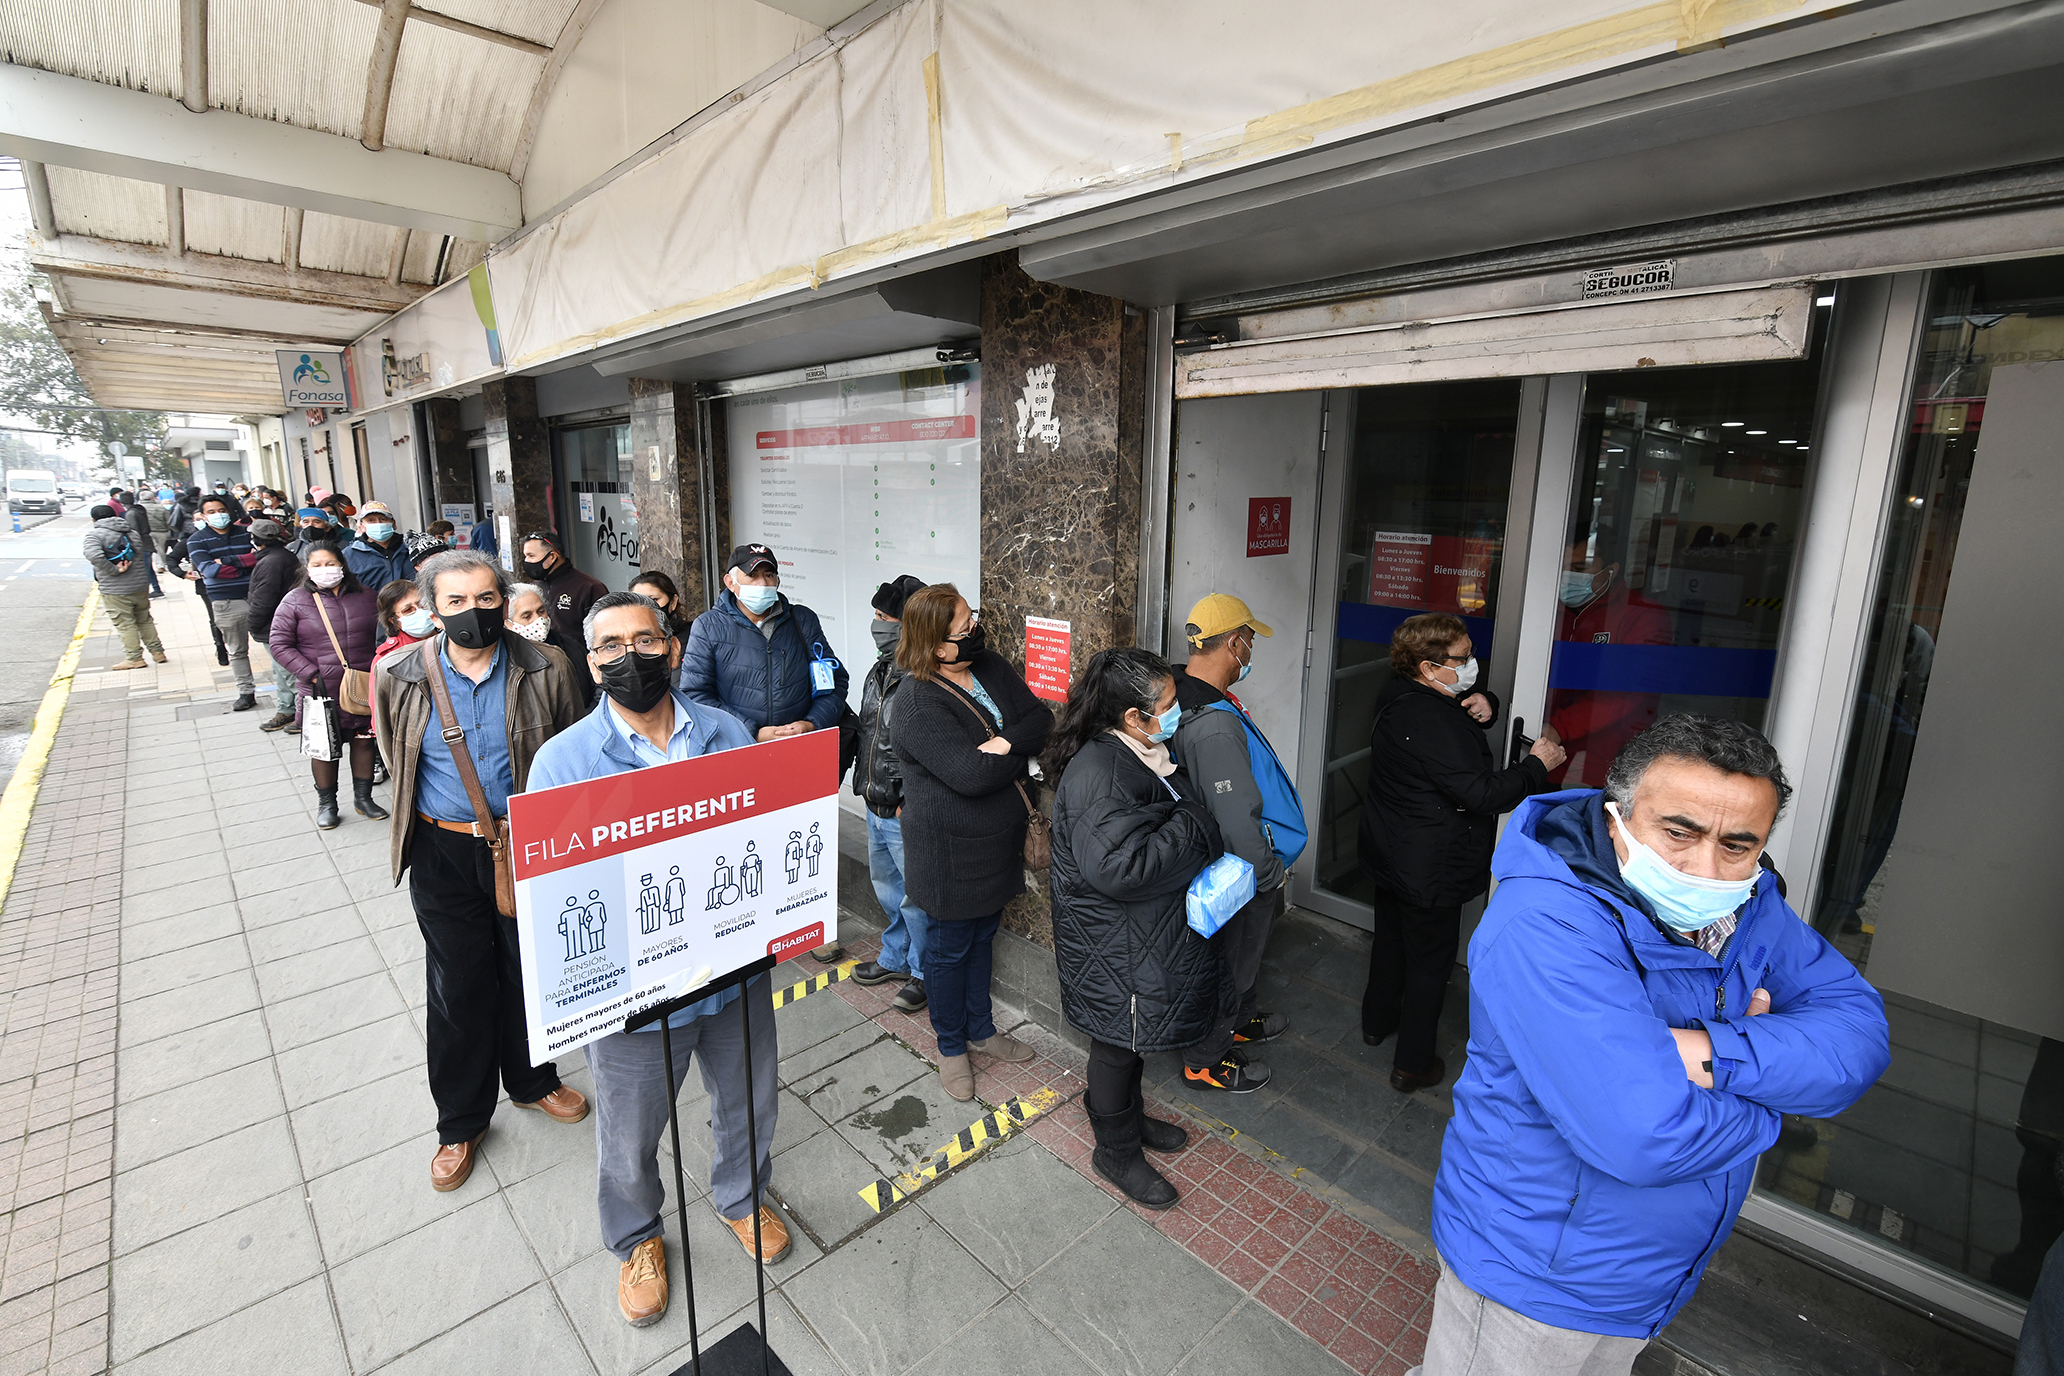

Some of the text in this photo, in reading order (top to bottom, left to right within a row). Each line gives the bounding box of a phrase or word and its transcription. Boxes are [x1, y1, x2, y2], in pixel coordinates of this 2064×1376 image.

[1586, 270, 1670, 291] SEGUCOR
[1641, 284, 1670, 292] 2713387
[1041, 380, 1048, 390] de
[289, 388, 344, 402] Fonasa
[934, 420, 954, 428] CENTER
[1249, 538, 1288, 550] MASCARILLA
[1403, 548, 1422, 556] Jueves
[1434, 565, 1486, 578] Bienvenidos
[1388, 582, 1409, 590] Sábado
[1028, 618, 1068, 630] Horario atención
[1049, 636, 1064, 644] Jueves
[1039, 654, 1056, 662] Viernes
[1039, 673, 1056, 682] Sábado
[1058, 686, 1066, 694] hrs.
[524, 788, 756, 865] FILA PREFERENTE
[786, 886, 818, 903] MUJERES
[776, 891, 828, 916] EMBARAZADAS
[714, 910, 756, 930] MOVILIDAD
[715, 920, 756, 938] REDUCIDA
[642, 936, 684, 956] MAYORES
[782, 928, 820, 950] HABITAT
[637, 943, 689, 967] DE 60 AÑOS
[564, 954, 607, 976] PENSIÓN
[558, 962, 616, 988] ANTICIPADA
[545, 966, 626, 1002] PARA ENFERMOS
[555, 980, 618, 1008] TERMINALES
[546, 984, 666, 1036] Mujeres mayores de 60 años
[548, 1029, 588, 1052] Hombres
[590, 1015, 626, 1034] mayores
[626, 1008, 638, 1018] de
[638, 1002, 649, 1012] 65
